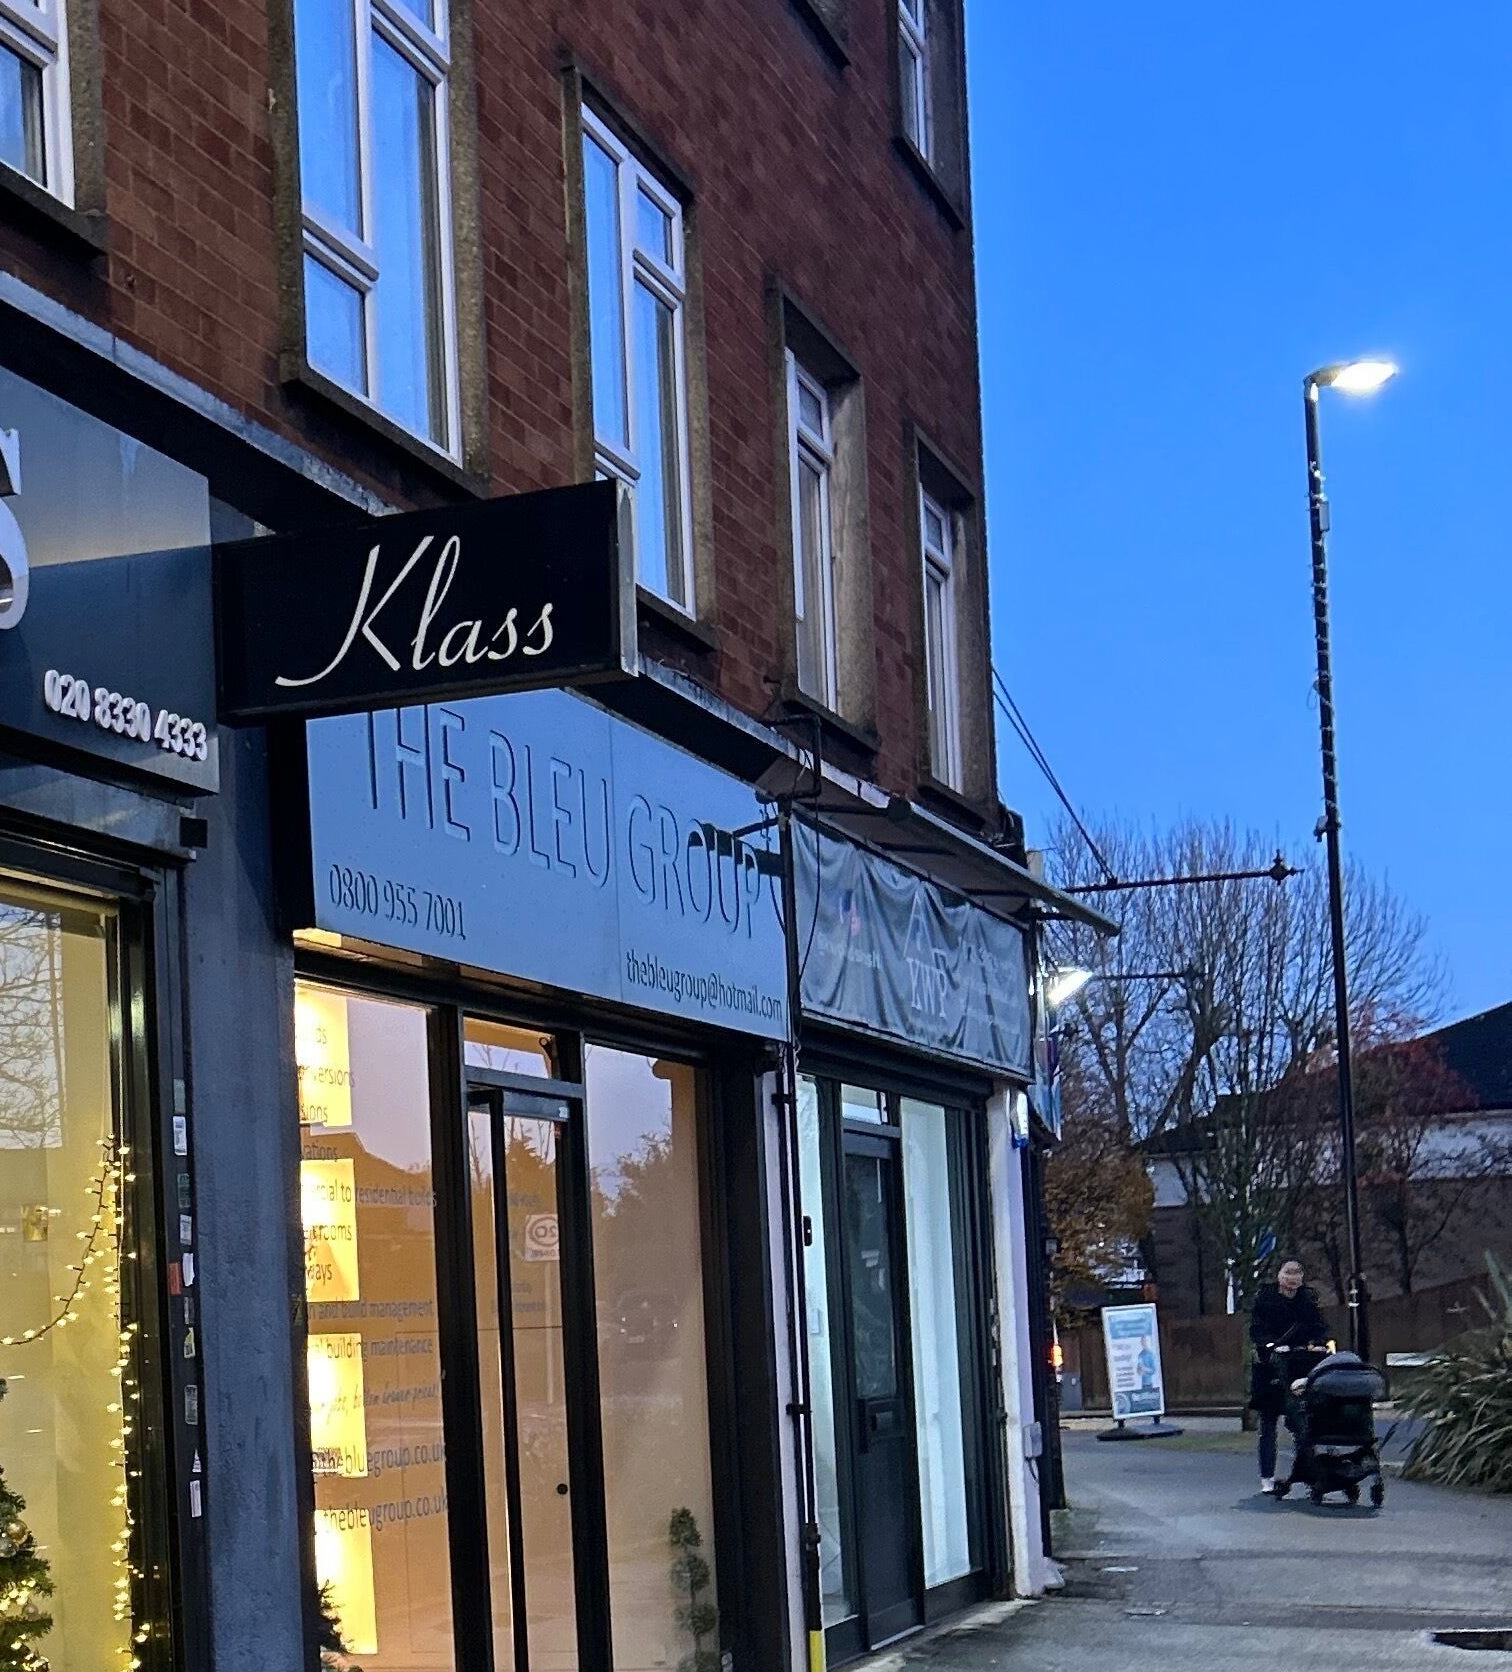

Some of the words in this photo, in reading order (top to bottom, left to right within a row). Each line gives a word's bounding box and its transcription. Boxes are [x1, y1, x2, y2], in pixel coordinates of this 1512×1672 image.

[274, 535, 554, 687] Klass
[44, 669, 91, 722] 020
[94, 687, 152, 743] 8330
[154, 709, 208, 761] 4333
[488, 729, 610, 889] BLEU
[628, 793, 761, 940] GROUP
[329, 863, 379, 916] 0800
[384, 879, 418, 928] 955
[423, 891, 467, 941] 7001
[626, 949, 783, 1022] thebleugroup@hotmail.com
